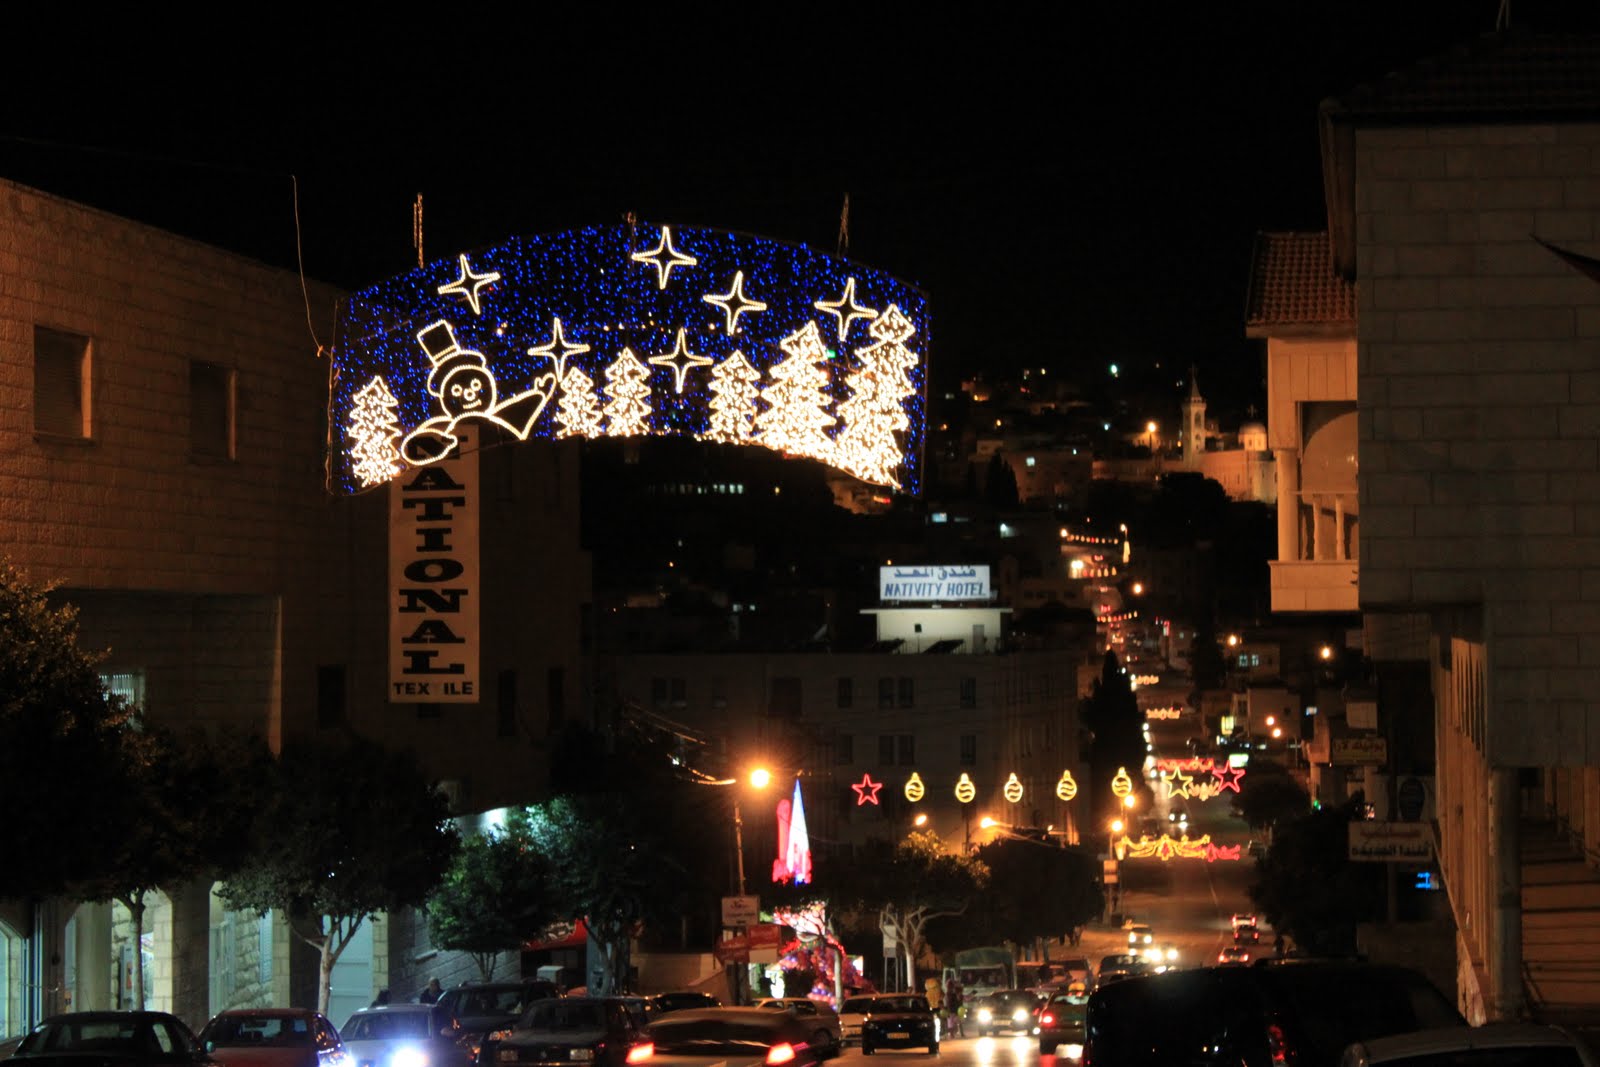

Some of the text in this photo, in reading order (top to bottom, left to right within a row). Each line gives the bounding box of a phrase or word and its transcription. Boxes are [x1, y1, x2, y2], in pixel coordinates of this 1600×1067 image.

[399, 435, 468, 674] NATIONAL
[938, 565, 977, 580] فندق
[884, 582, 986, 597] NATIVITY HOTEL
